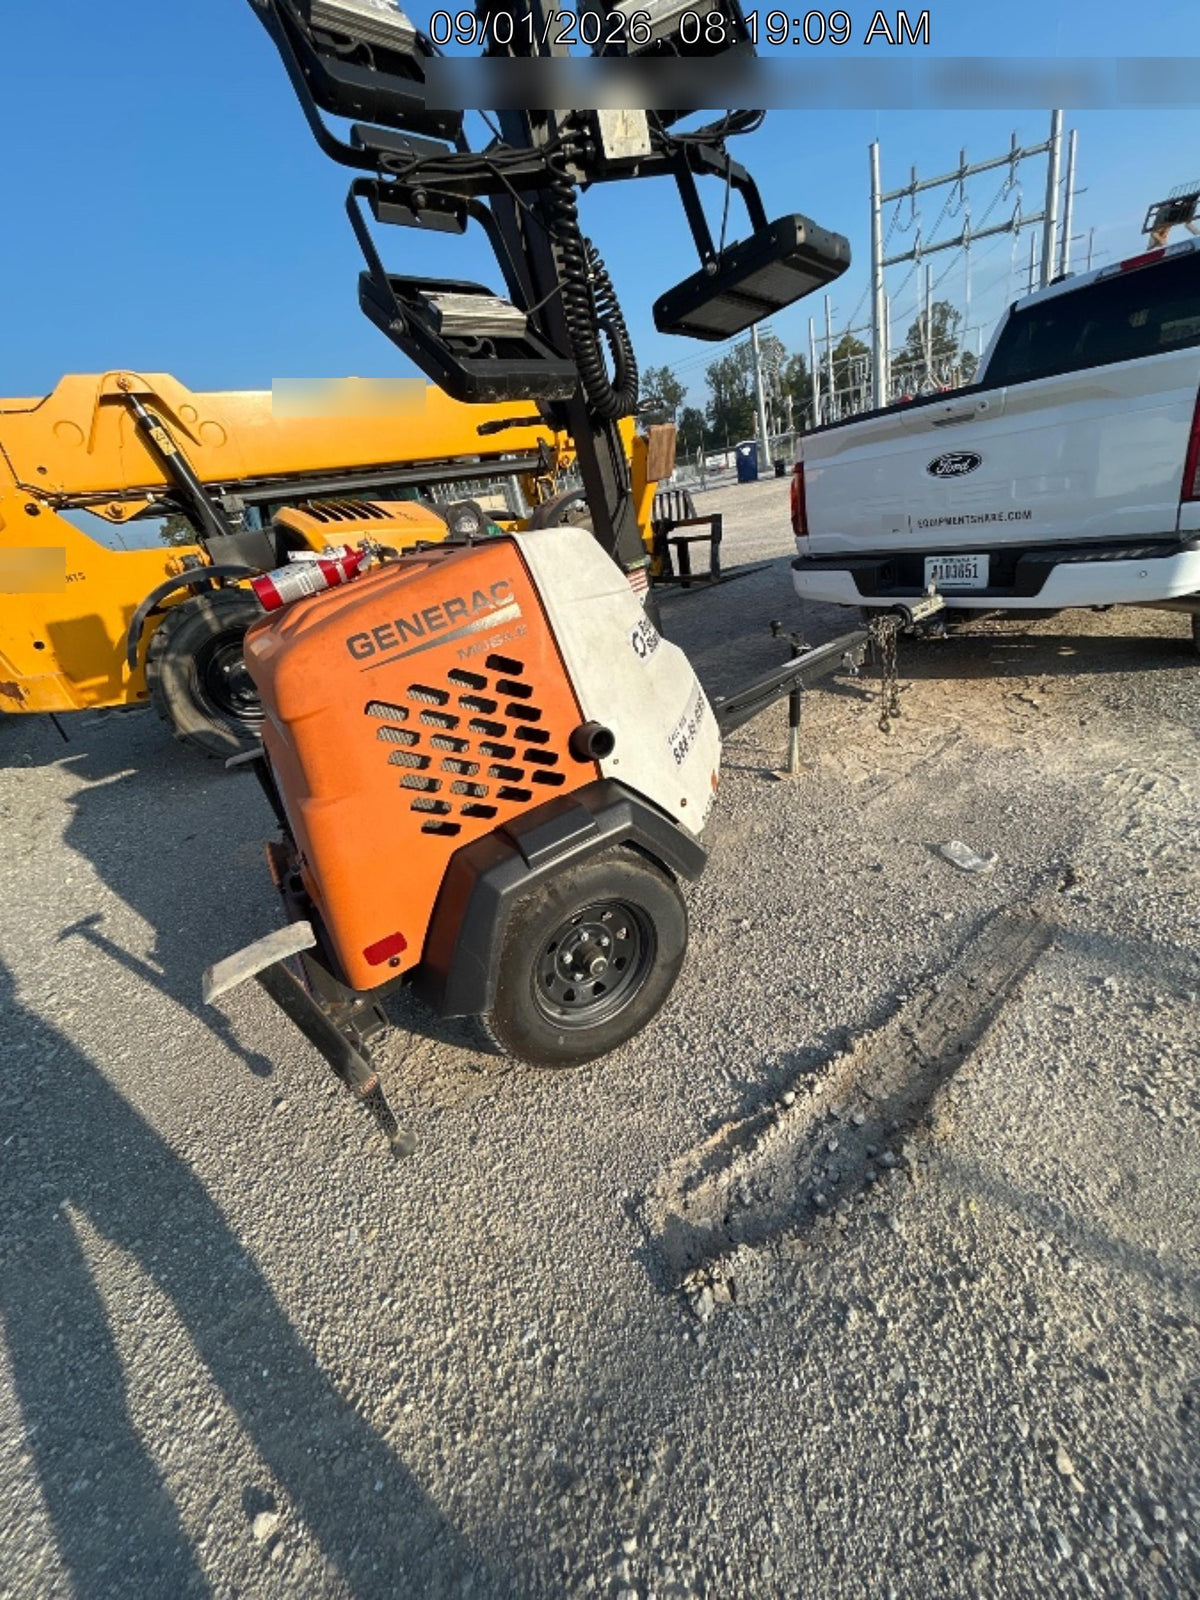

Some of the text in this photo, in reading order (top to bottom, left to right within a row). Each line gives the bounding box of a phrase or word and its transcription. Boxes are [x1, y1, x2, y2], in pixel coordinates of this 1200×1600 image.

[936, 456, 972, 475] Ford
[917, 510, 1033, 529] EQUIPMENTSHARE.COM
[346, 580, 515, 661] GENERAC
